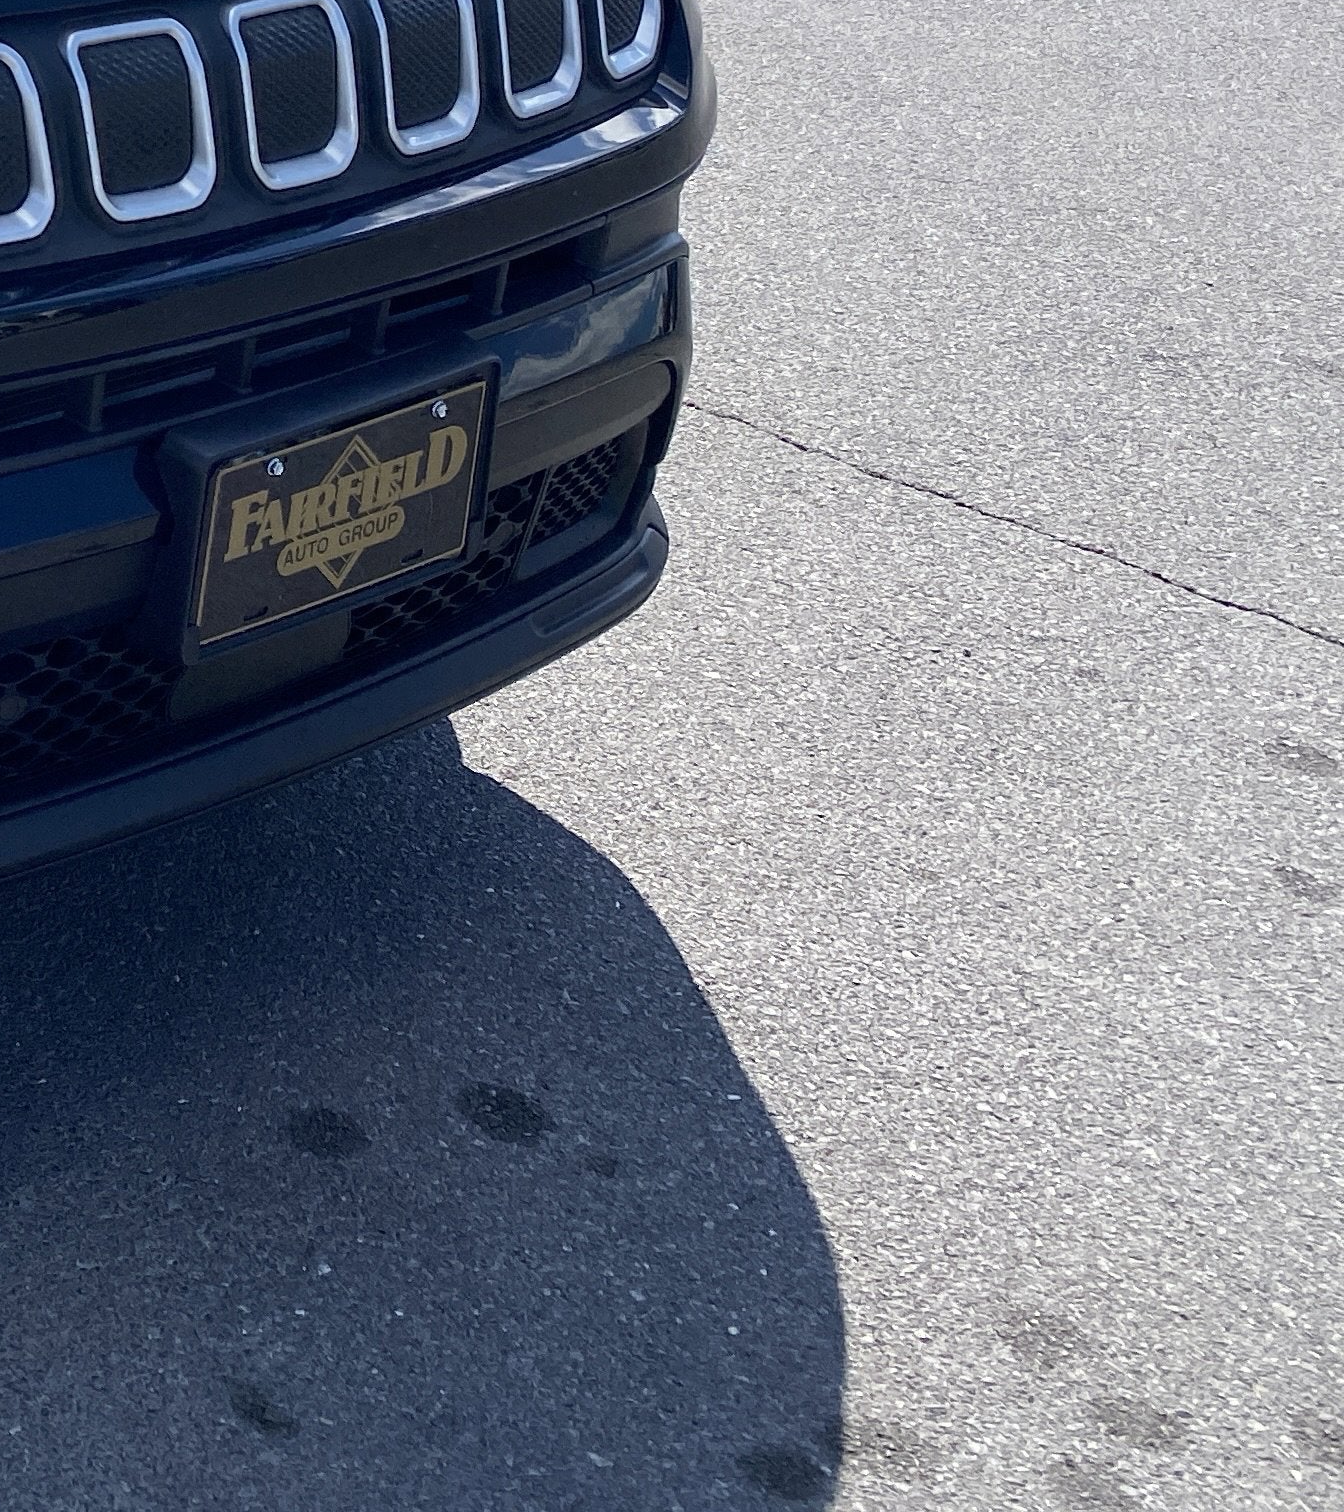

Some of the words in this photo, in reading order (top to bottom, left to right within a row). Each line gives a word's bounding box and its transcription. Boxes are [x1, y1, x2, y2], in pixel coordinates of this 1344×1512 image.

[223, 425, 468, 563] FAIRFIELD
[282, 536, 330, 568] AUTO
[338, 510, 399, 547] GROUP
